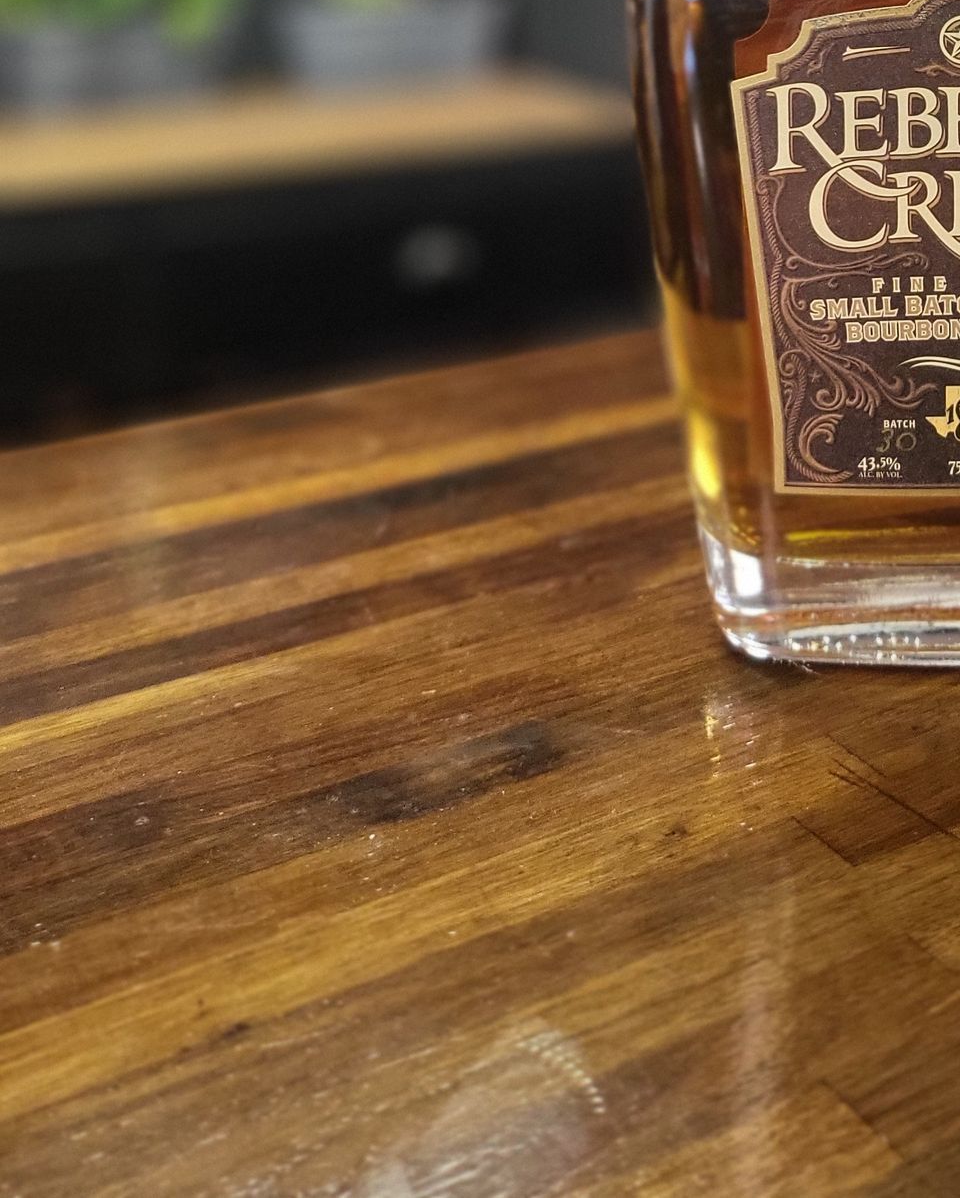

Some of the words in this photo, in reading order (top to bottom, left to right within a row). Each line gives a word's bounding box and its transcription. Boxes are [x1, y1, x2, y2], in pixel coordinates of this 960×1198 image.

[872, 276, 947, 293] FINE
[810, 296, 899, 320] SMALL
[883, 419, 916, 429] BATCH
[857, 457, 901, 471] 43.5%
